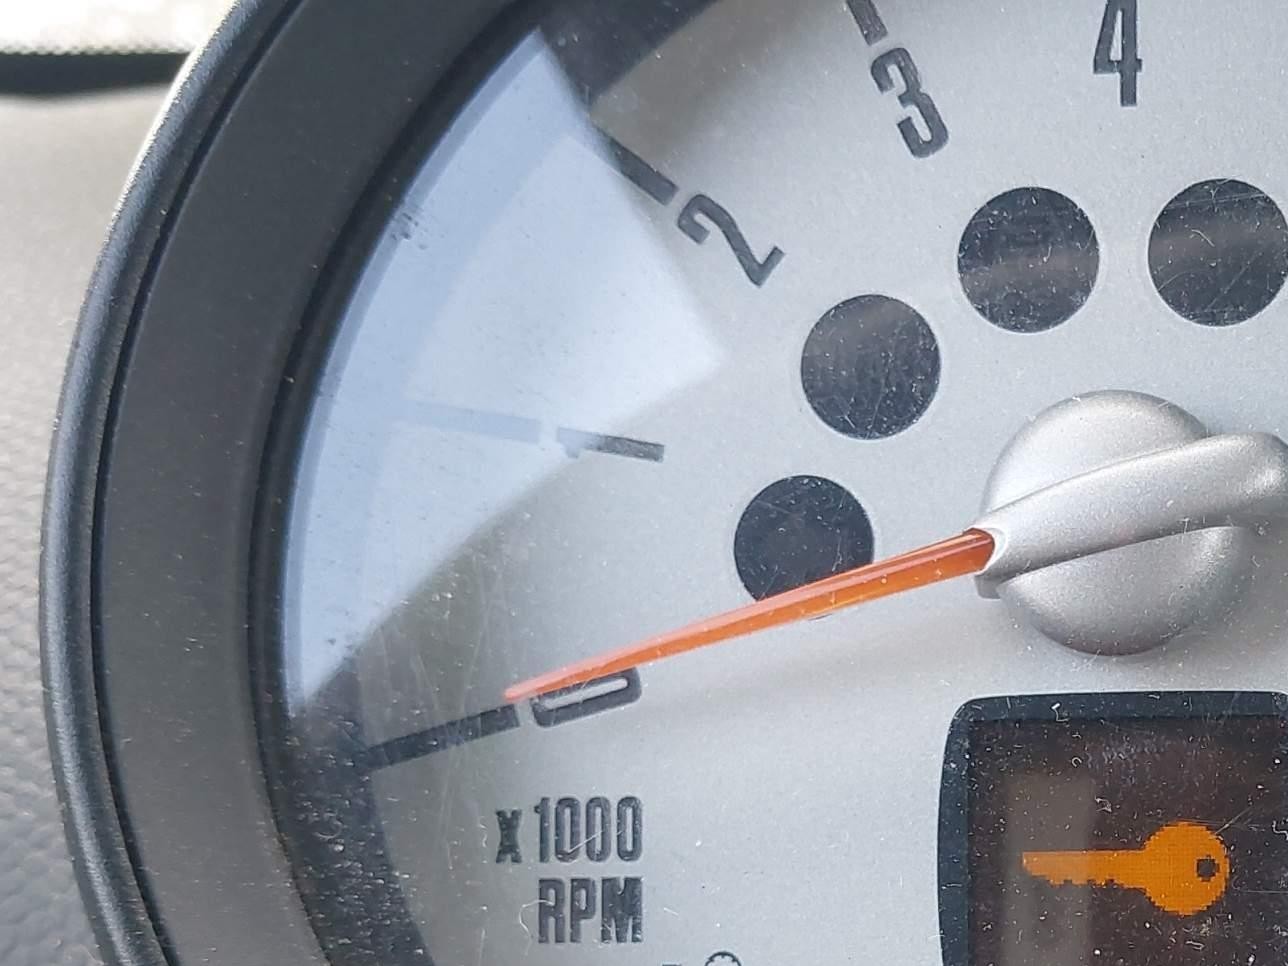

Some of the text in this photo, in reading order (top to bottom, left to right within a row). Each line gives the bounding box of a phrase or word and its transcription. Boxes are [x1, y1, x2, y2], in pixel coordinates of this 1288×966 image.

[1092, 0, 1143, 107] 4
[870, 47, 948, 158] 3
[677, 193, 785, 288] 2
[533, 796, 644, 863] 1000
[537, 876, 644, 944] RPM
